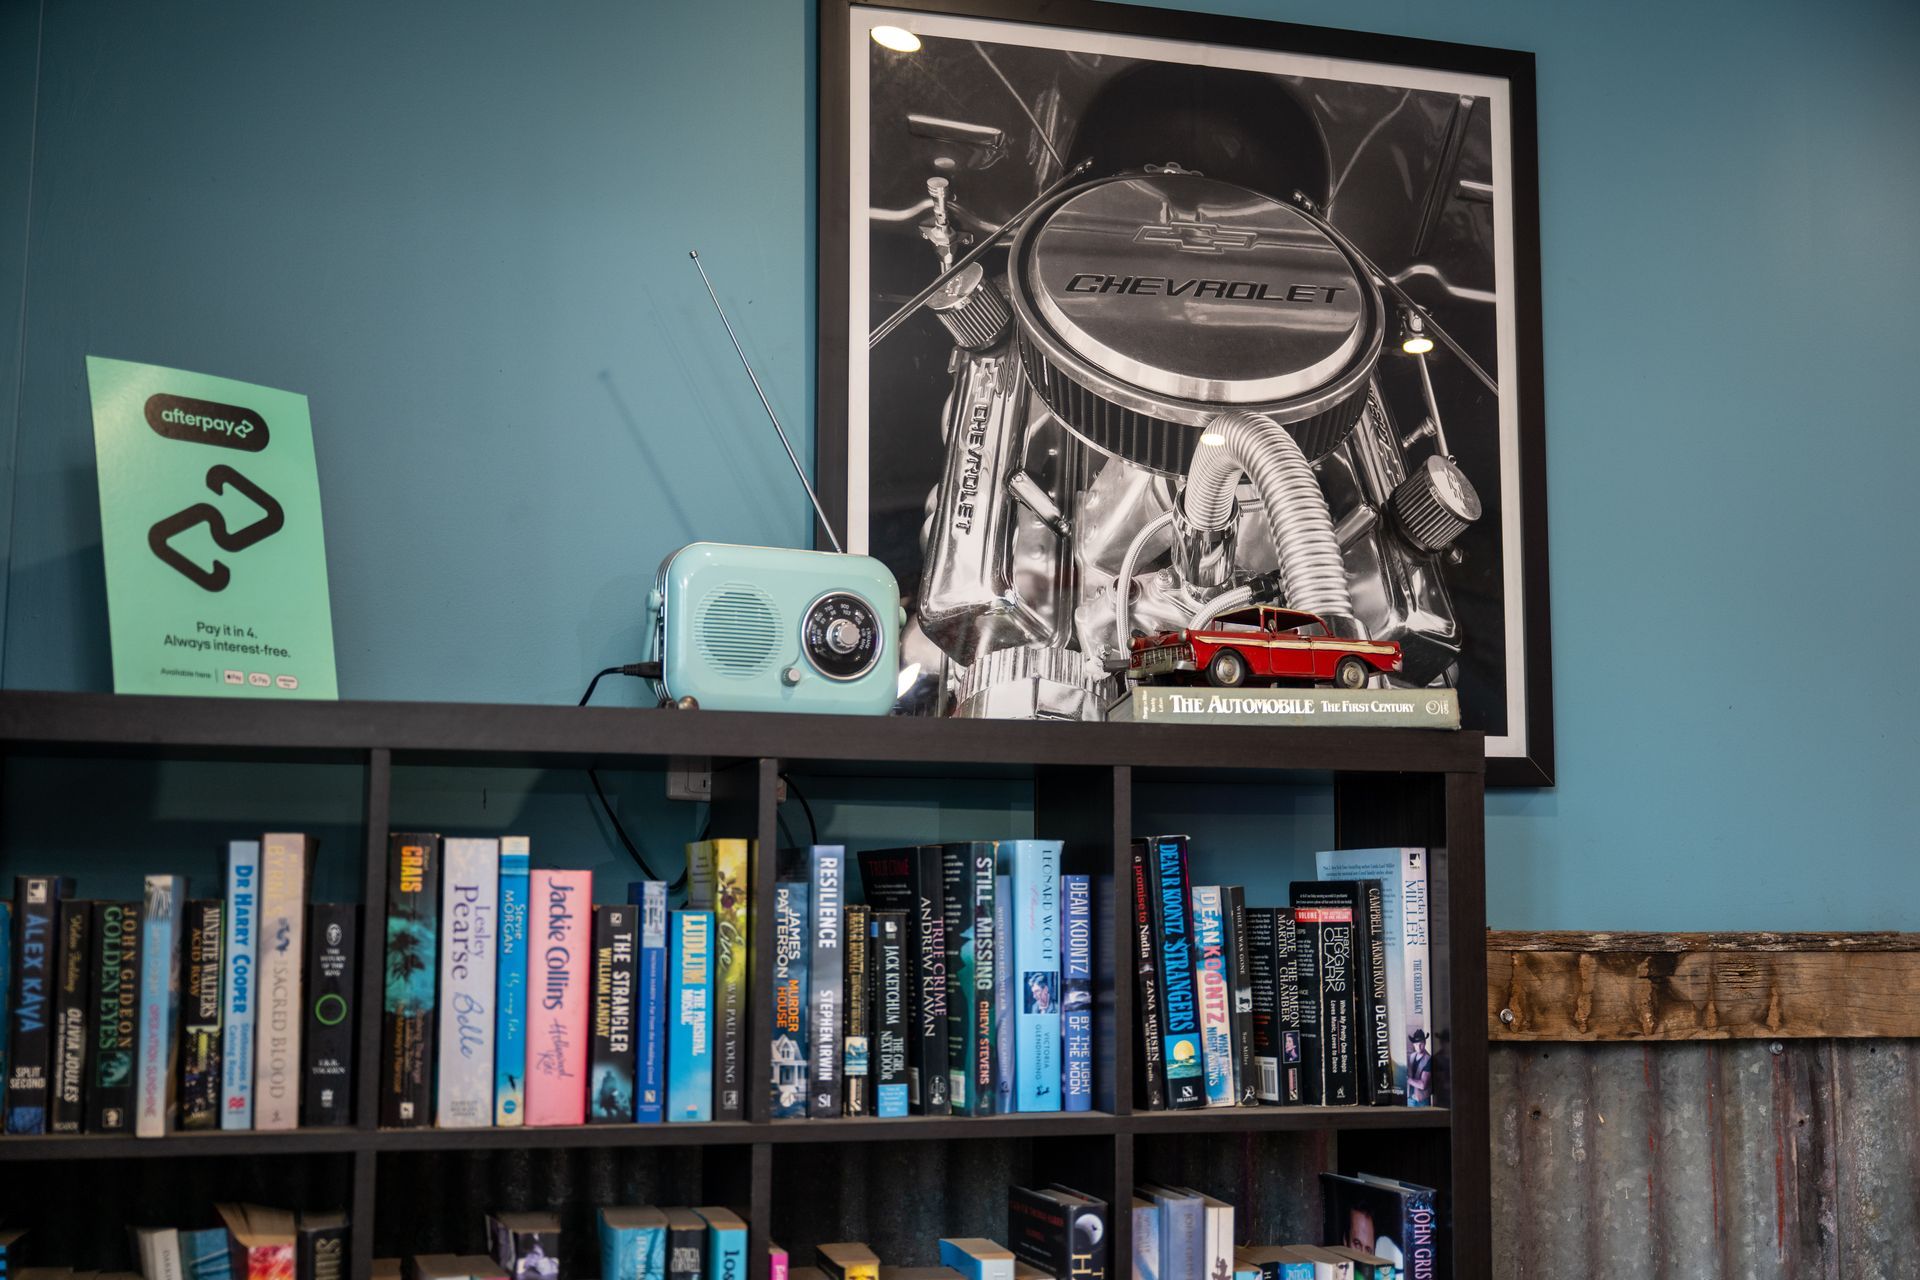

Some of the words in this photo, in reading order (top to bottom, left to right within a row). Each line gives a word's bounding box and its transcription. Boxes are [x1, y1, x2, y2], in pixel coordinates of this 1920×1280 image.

[1065, 273, 1346, 303] CHEVROLET
[161, 408, 235, 435] afterpay
[956, 404, 988, 535] CHEVROLET
[164, 635, 211, 651] Always
[213, 640, 291, 658] interest-free.
[196, 621, 219, 637] Pay
[223, 624, 230, 636] it
[234, 625, 244, 637] in
[247, 627, 258, 639] 4.
[1169, 695, 1204, 713] THE
[1207, 695, 1315, 714] AUTOMOBILE
[1321, 700, 1340, 712] THE
[1341, 700, 1370, 713] FIRST
[1370, 700, 1415, 713] CENTURY
[234, 865, 253, 889] DR
[400, 845, 423, 893] CRAIS
[976, 857, 993, 906] STILL
[1042, 849, 1053, 910] LEONARD
[1159, 843, 1180, 876] DEAN
[1162, 877, 1180, 887] R
[548, 877, 575, 942] Jackie
[818, 857, 838, 948] RESILIENCE
[1070, 882, 1089, 915] DEAN
[1133, 865, 1147, 910] promise
[1416, 879, 1426, 915] Linda
[122, 907, 137, 961] JOHN
[202, 907, 220, 961] MINETTE
[234, 892, 253, 947] HARRY
[452, 885, 479, 980] Pearse
[474, 906, 491, 960] Lesley
[503, 889, 514, 954] MORGAN
[514, 903, 525, 940] Stevie
[777, 888, 788, 978] PATTERSON
[788, 908, 801, 960] JAMES
[920, 896, 934, 969] ANDREW
[1138, 911, 1147, 922] to
[1162, 888, 1184, 934] KOONTZ
[1200, 893, 1220, 943] DEAN
[1235, 905, 1243, 929] WHILE
[1369, 888, 1382, 936] CAMPBELL
[1405, 880, 1418, 946] MILLER
[1417, 918, 1427, 946] Lael
[25, 914, 49, 969] ALEX
[102, 906, 122, 993] GOLDEN
[190, 927, 202, 961] ACID
[613, 932, 632, 963] THE
[682, 914, 707, 985] LUDLUM
[719, 921, 744, 972] Eve
[884, 945, 900, 971] JACK
[932, 916, 946, 959] TRUE
[976, 917, 993, 990] MISSING
[1042, 916, 1053, 963] WOOLF
[1070, 919, 1089, 974] KOONTZ
[1139, 924, 1150, 958] Nadia
[1277, 914, 1288, 958] MARTINI
[1285, 919, 1296, 952] STEVE
[189, 965, 201, 998] ROW
[542, 946, 571, 1010] Collins
[598, 947, 612, 993] WILLIAM
[1287, 960, 1298, 983] THE
[1324, 927, 1335, 992] CLARK
[1334, 927, 1345, 992] HIGGINS
[1371, 940, 1386, 998] ARMSTRONG
[1413, 960, 1422, 972] THE
[15, 978, 46, 1032] KAVA
[199, 963, 218, 1018] WALTERS
[232, 953, 251, 1014] COOPER
[271, 966, 290, 1031] SACRED
[693, 989, 706, 1009] THE
[788, 979, 800, 1032] MURDER
[885, 973, 900, 1025] KETCHUM
[923, 976, 936, 1037] KLAVAN
[933, 963, 947, 1017] CRIME
[1146, 980, 1155, 1010] ZANA
[1163, 937, 1194, 1032] STRANGERS
[1203, 945, 1225, 1024] KOONTZ
[1279, 967, 1290, 1022] CHAMBER
[1289, 984, 1300, 1028] SIMEON
[1413, 992, 1423, 1015] LEGACY
[66, 1007, 83, 1051] OLIVIA
[99, 997, 119, 1049] EYES
[119, 969, 134, 1048] GIDEON
[454, 991, 484, 1059] Belle
[596, 996, 610, 1037] LANDAY
[610, 970, 630, 1052] STRANGLER
[681, 989, 694, 1025] MOSAIC
[725, 1008, 736, 1038] PAUL
[776, 987, 788, 1029] HOUSE
[819, 990, 833, 1041] STEPHEN
[979, 1001, 990, 1036] CHEVY
[1069, 1016, 1080, 1031] OF
[1081, 1016, 1089, 1031] BY
[1340, 1015, 1347, 1024] My
[692, 1010, 705, 1056] PARSIFAL
[881, 1030, 893, 1053] NEXT
[893, 1037, 904, 1052] THE
[1034, 1024, 1042, 1080] GLENDINNING
[1069, 1036, 1080, 1057] THE
[1081, 1036, 1090, 1057] THE
[1148, 1014, 1160, 1062] MUHSEN
[1206, 1027, 1218, 1053] NIGHT
[1375, 1005, 1389, 1067] DEADLINE
[10, 1078, 45, 1089] SECOND
[15, 1066, 41, 1078] SPLIT
[64, 1053, 81, 1103] JOULES
[269, 1037, 288, 1099] BLOOD
[724, 1040, 736, 1084] YOUNG
[819, 1045, 834, 1081] IRWIN
[881, 1054, 893, 1080] DOOR
[892, 1054, 904, 1072] GIRL
[979, 1038, 989, 1085] STEVENS
[1069, 1061, 1080, 1096] MOON
[1081, 1061, 1091, 1094] LIGHT
[1409, 1207, 1432, 1245] JOHN
